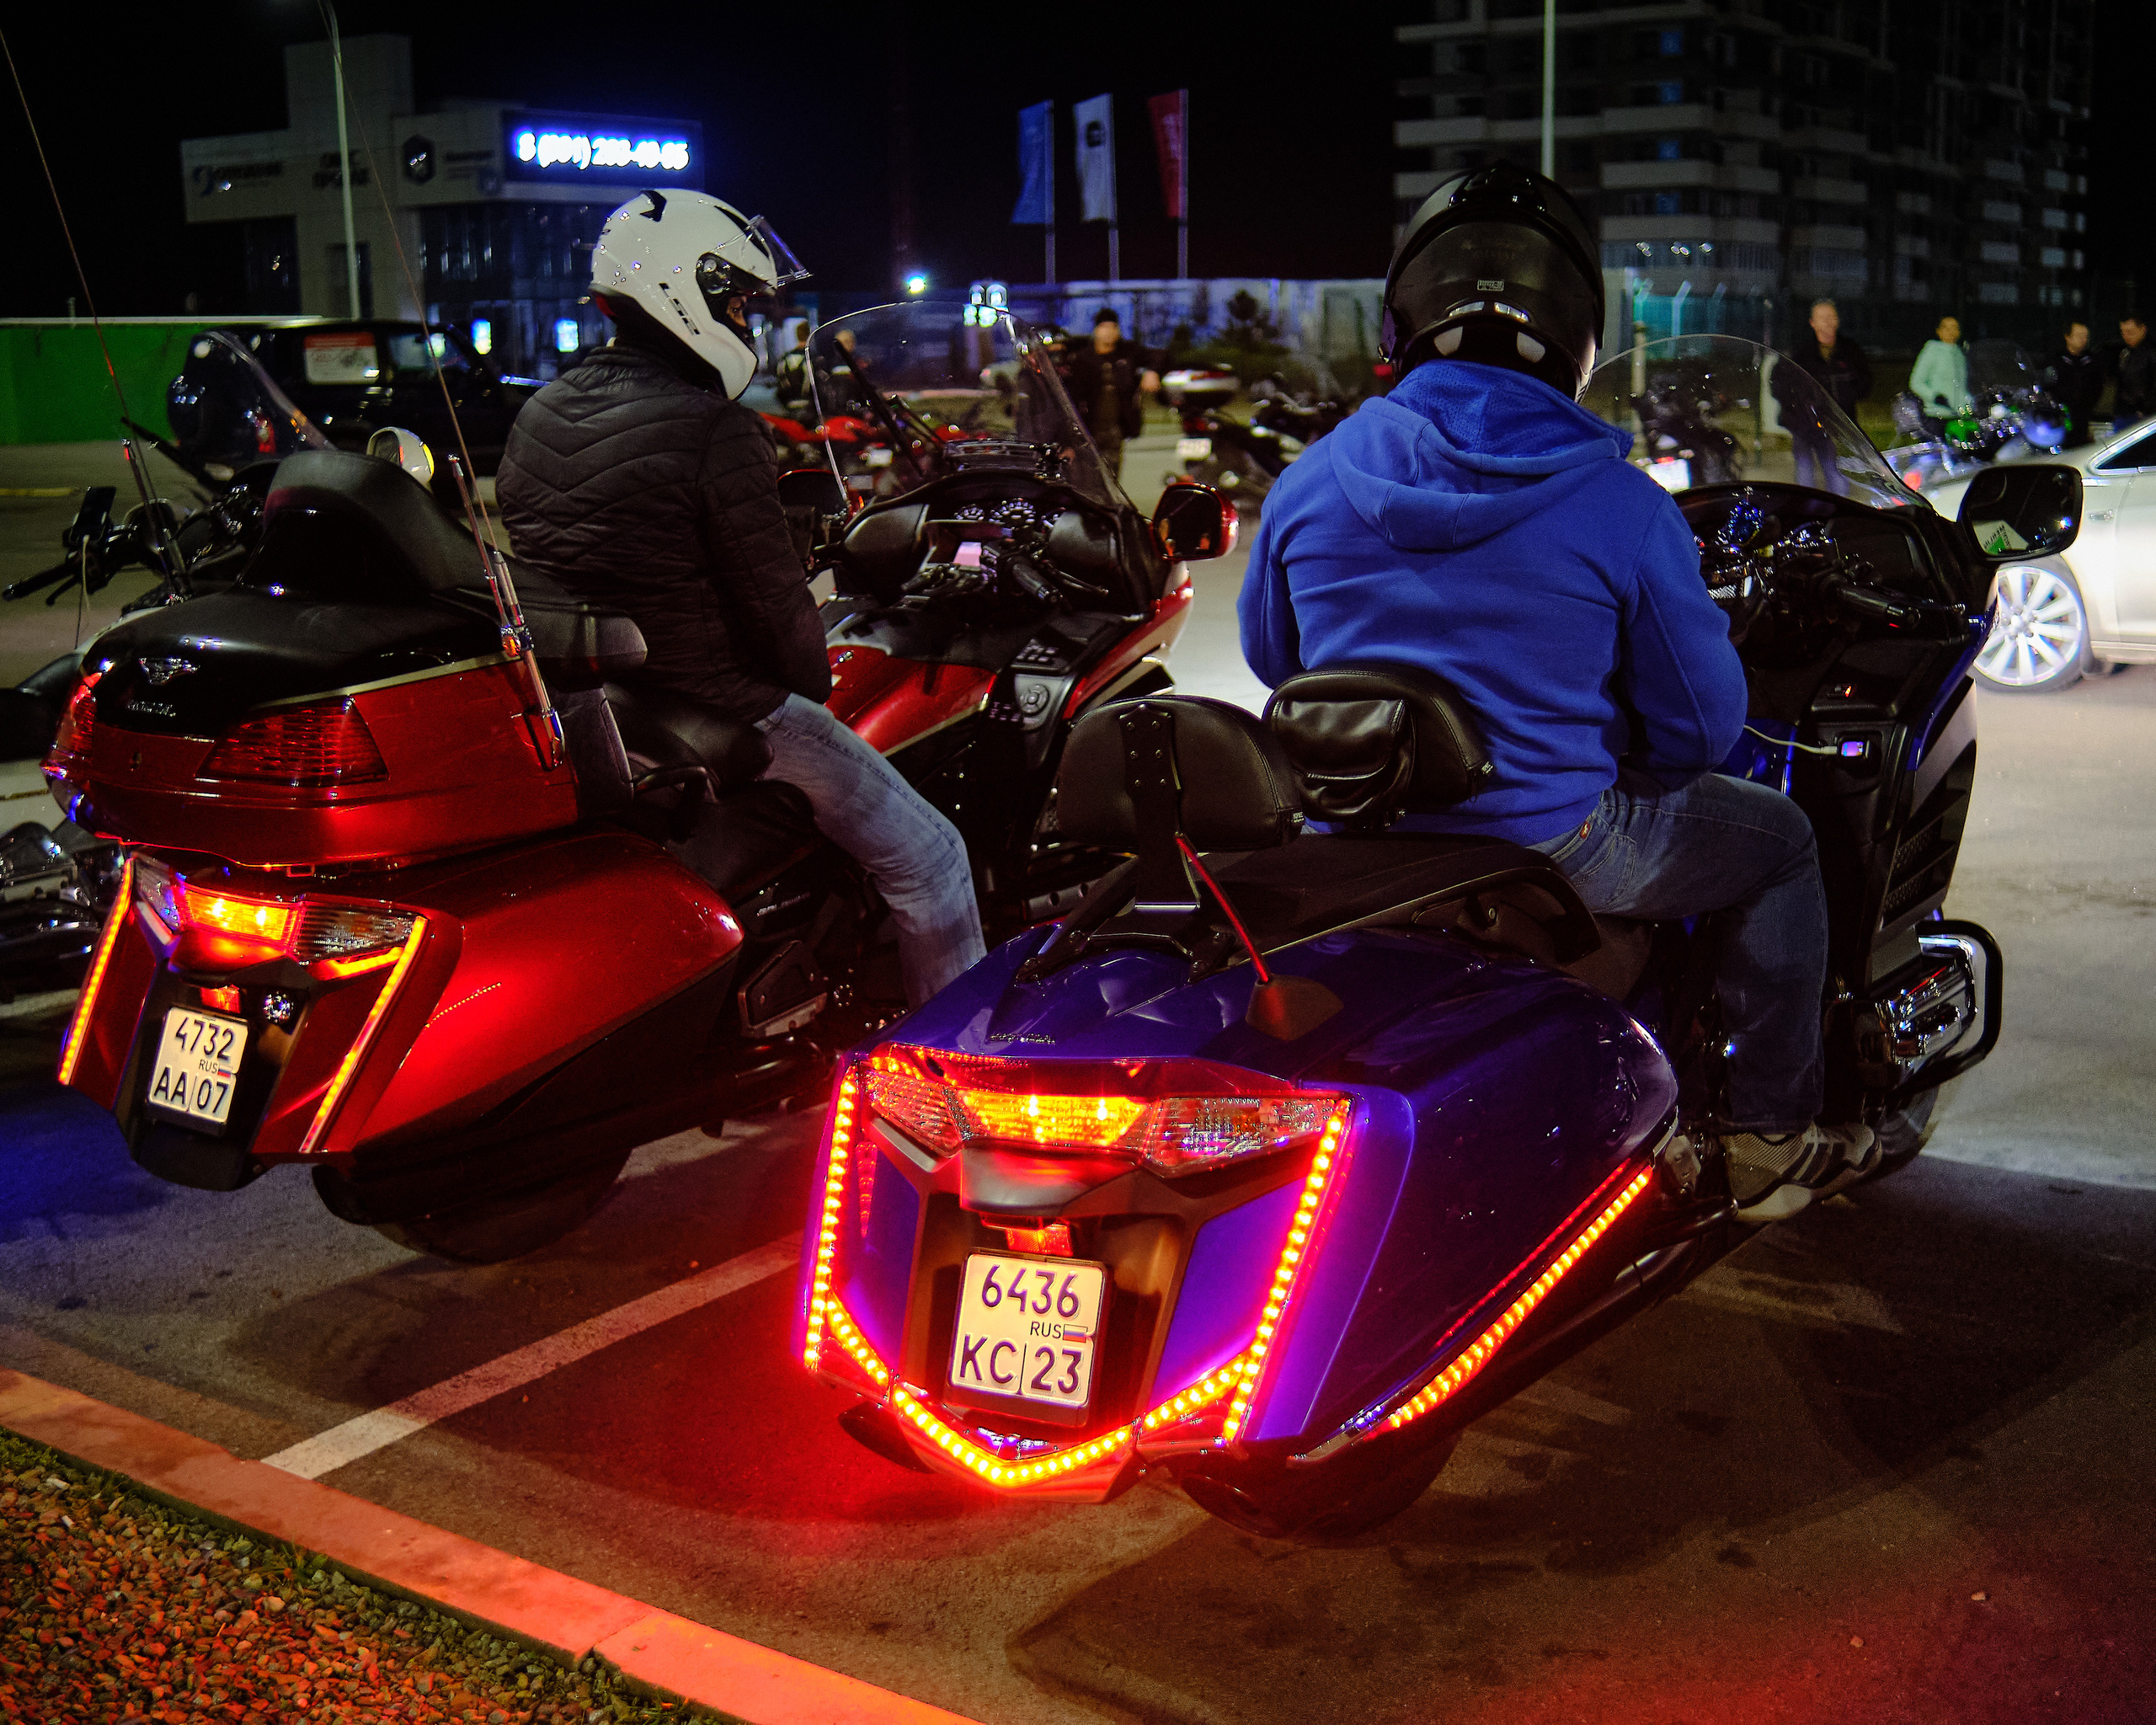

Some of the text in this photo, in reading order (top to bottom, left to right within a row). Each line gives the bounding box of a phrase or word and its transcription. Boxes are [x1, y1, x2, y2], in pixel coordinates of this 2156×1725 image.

[175, 1017, 236, 1061] 4732
[198, 1059, 218, 1074] RUS
[153, 1066, 230, 1114] AA 07
[980, 1263, 1080, 1318] 6436
[1030, 1321, 1062, 1339] RUS
[959, 1333, 1083, 1394] KC 23
